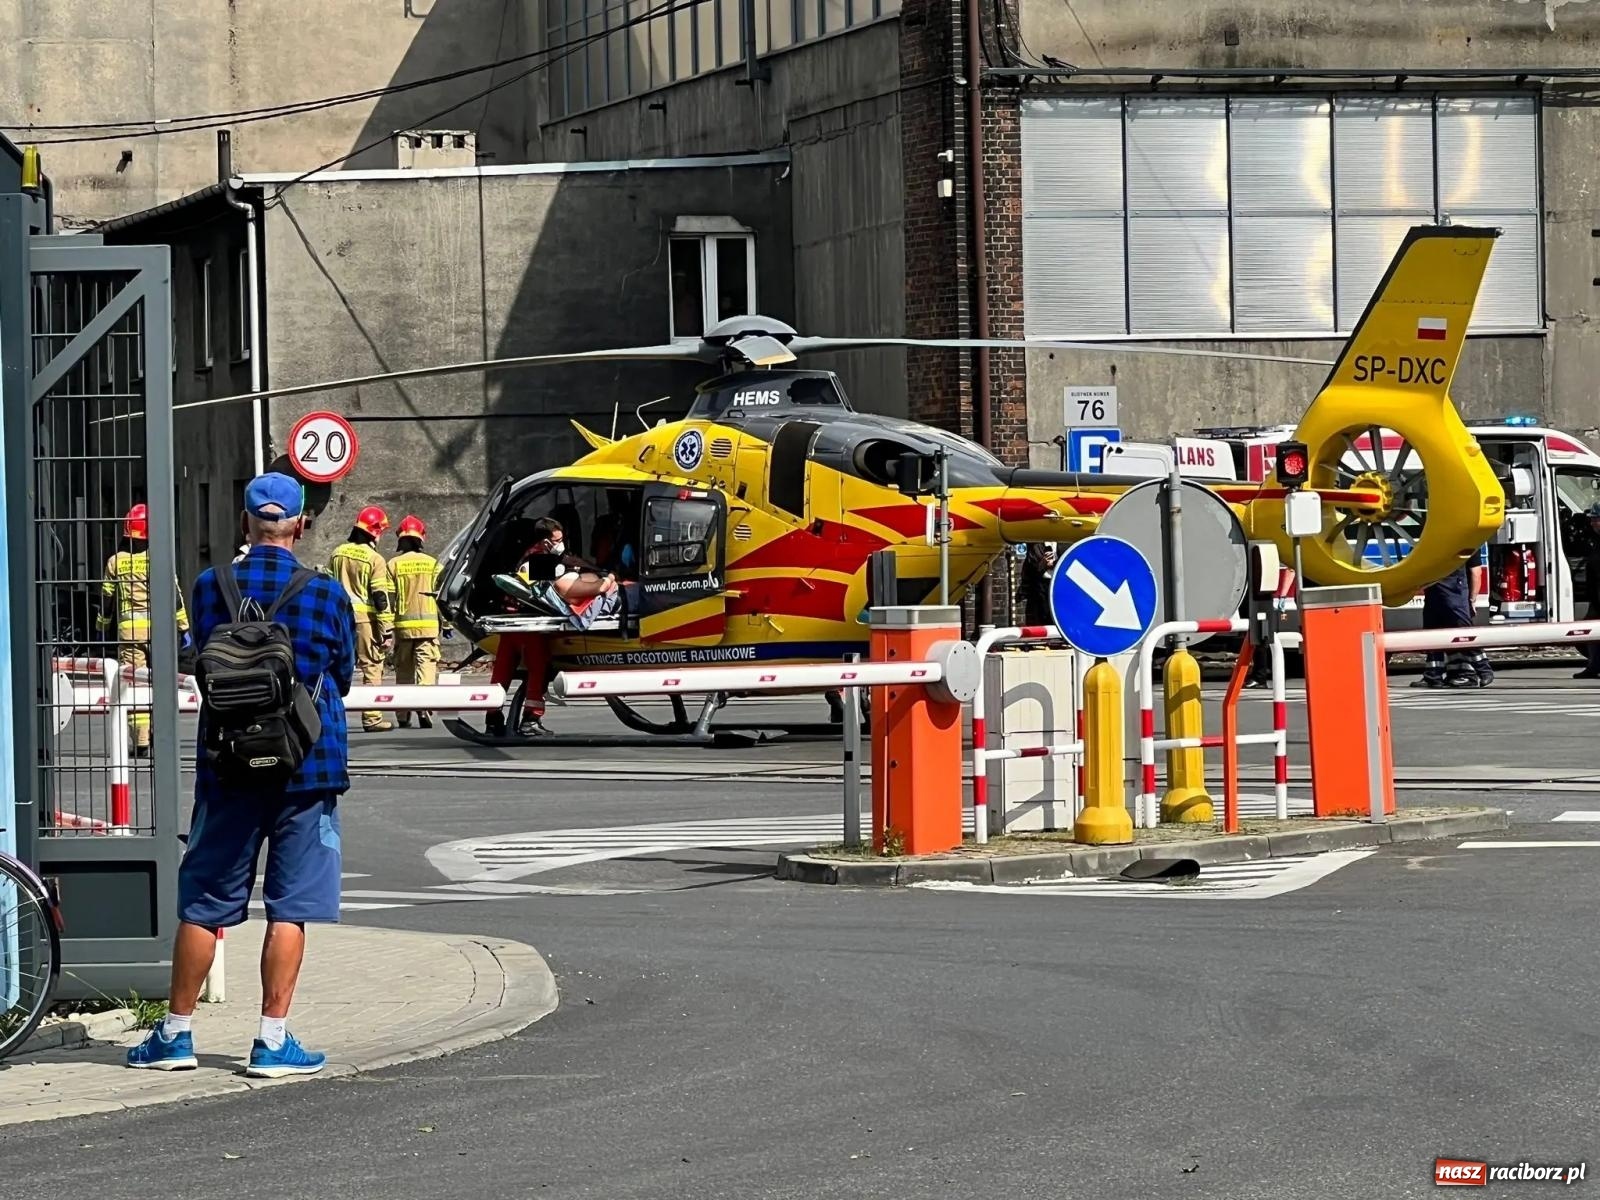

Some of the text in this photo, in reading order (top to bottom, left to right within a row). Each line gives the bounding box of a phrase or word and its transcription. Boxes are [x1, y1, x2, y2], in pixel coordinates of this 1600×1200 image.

[1353, 355, 1446, 385] SP-DXC
[733, 390, 780, 406] HEMS
[1077, 399, 1105, 421] 76
[300, 430, 346, 462] 20
[1174, 446, 1216, 467] LANS
[644, 579, 712, 593] www.lpr.com.pl
[576, 646, 757, 666] LOTNICZE POGOTOWIE RATUNKOWE
